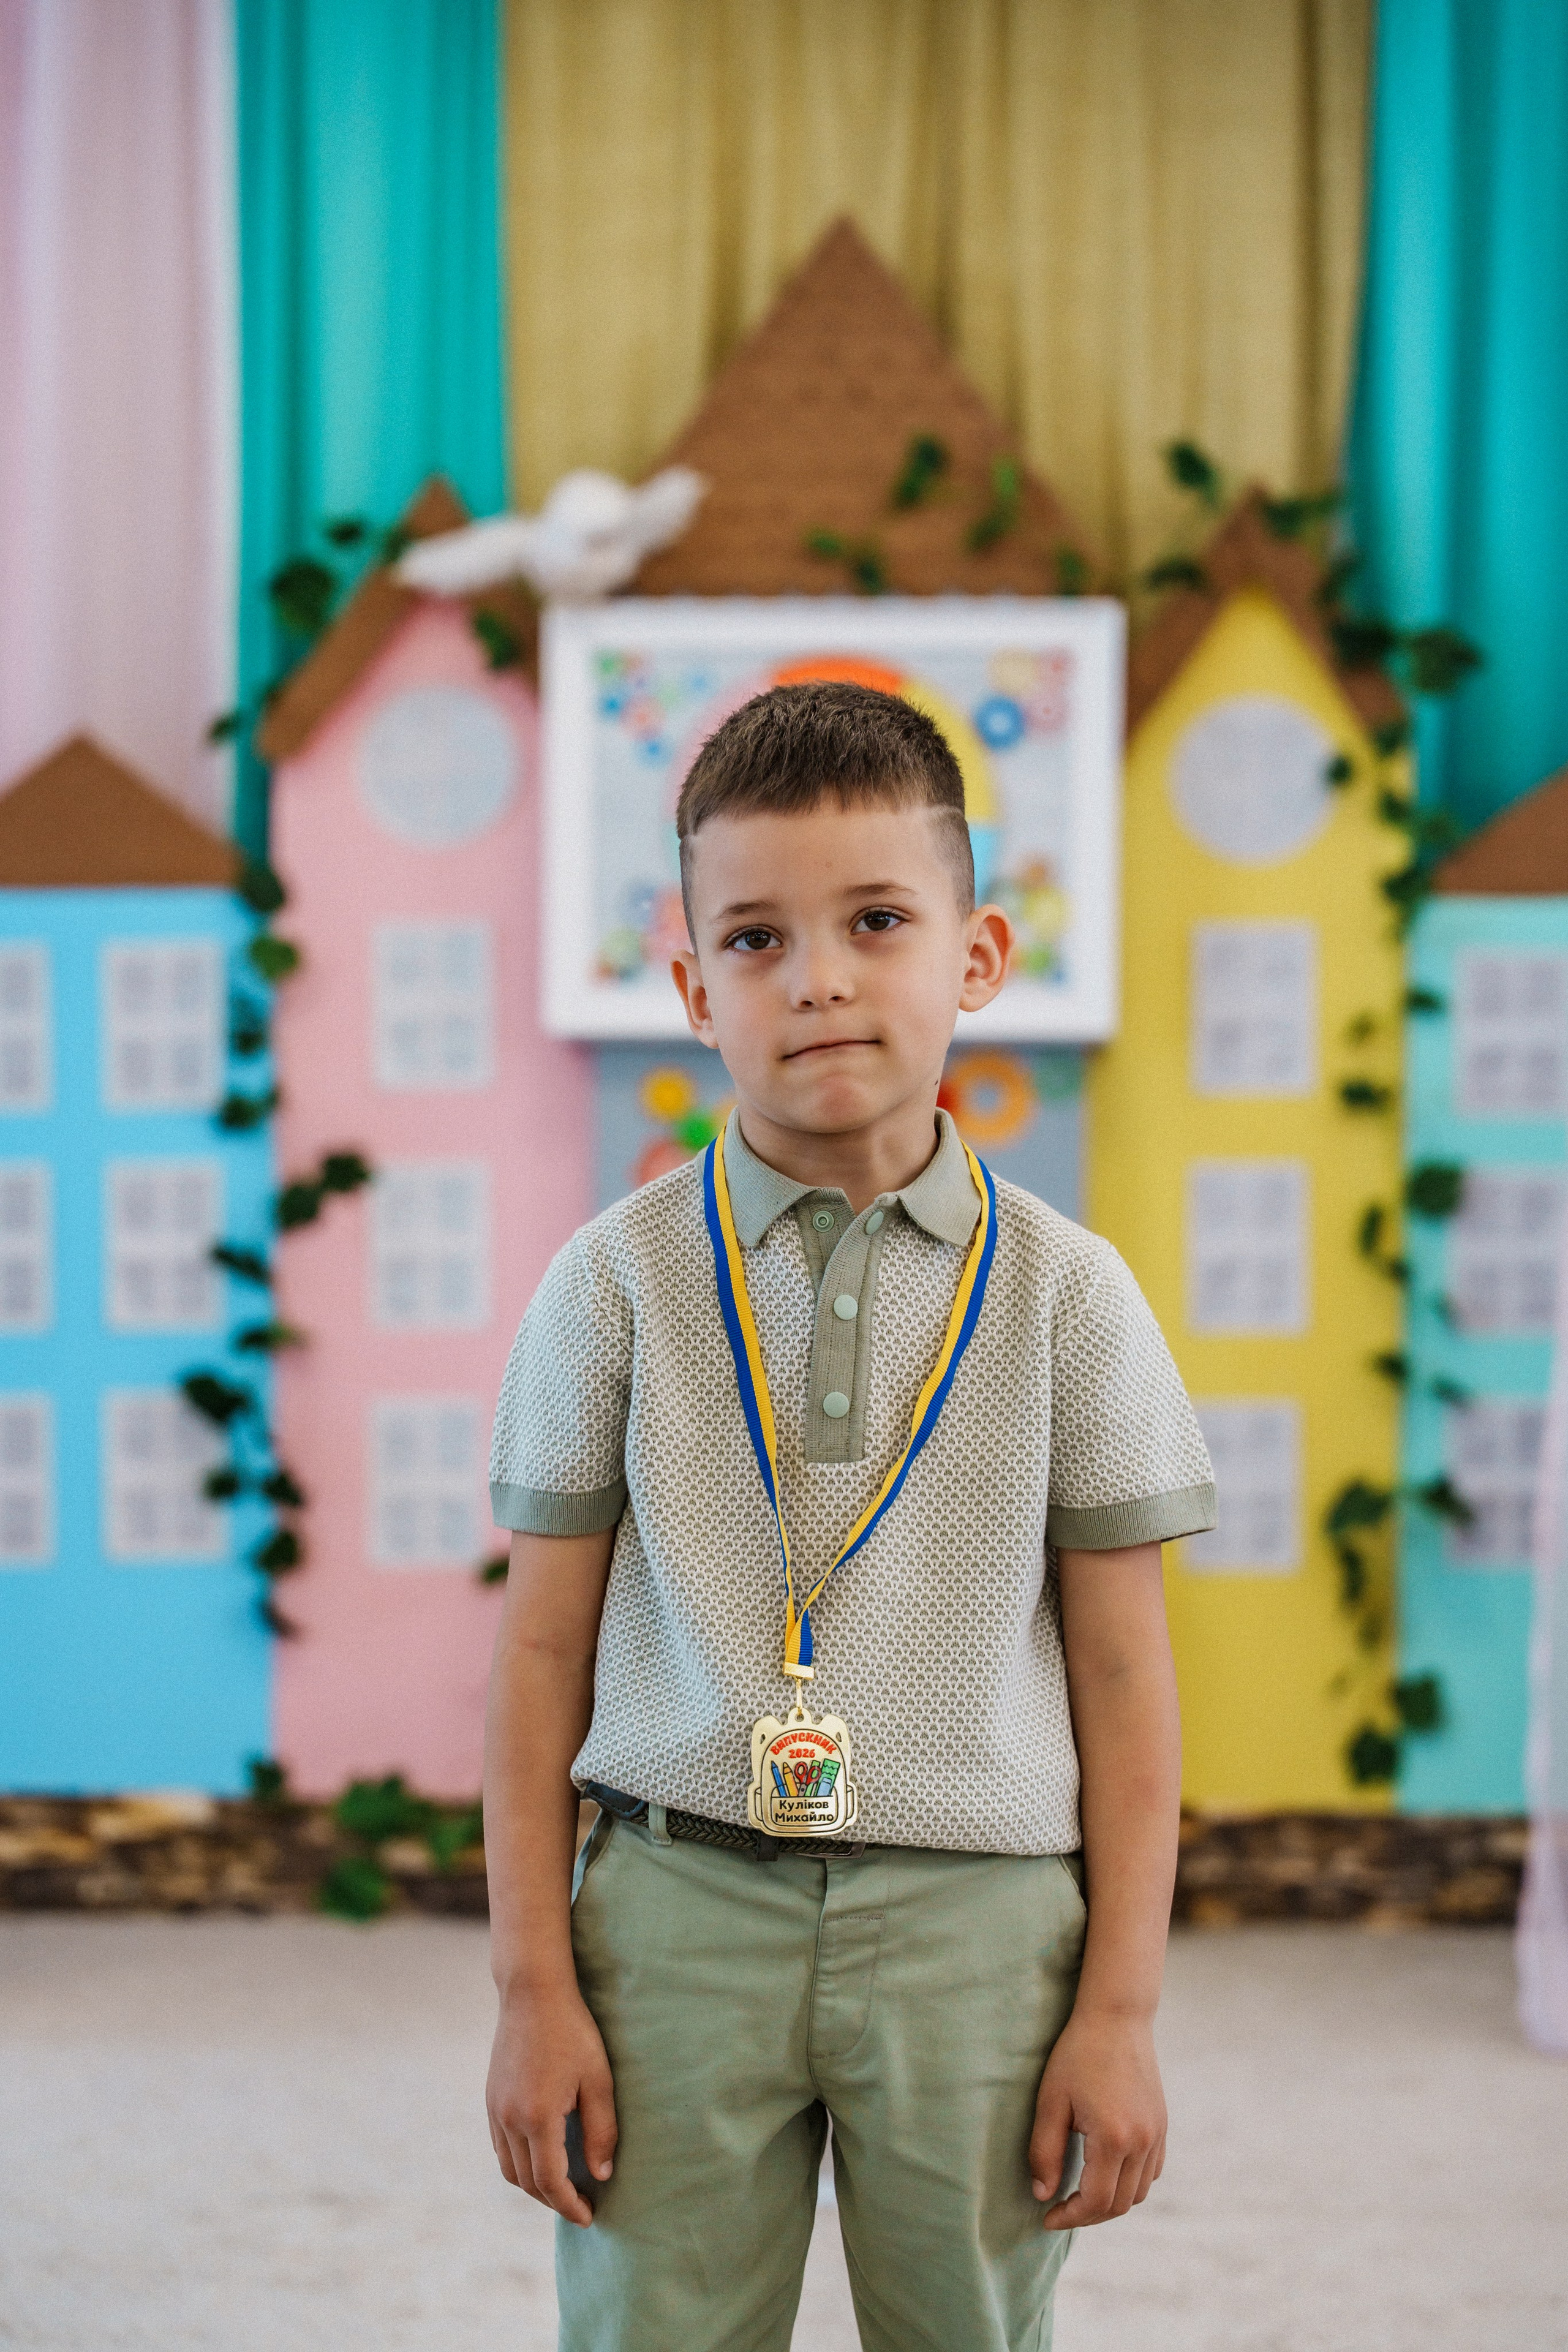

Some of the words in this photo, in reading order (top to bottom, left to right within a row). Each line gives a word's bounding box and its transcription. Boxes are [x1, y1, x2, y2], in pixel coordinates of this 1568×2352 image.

[770, 1732, 837, 1755] ВИПУСКНИК
[788, 1748, 816, 1758] 2026
[779, 1799, 829, 1812] Куліков
[775, 1812, 834, 1823] Михайло
